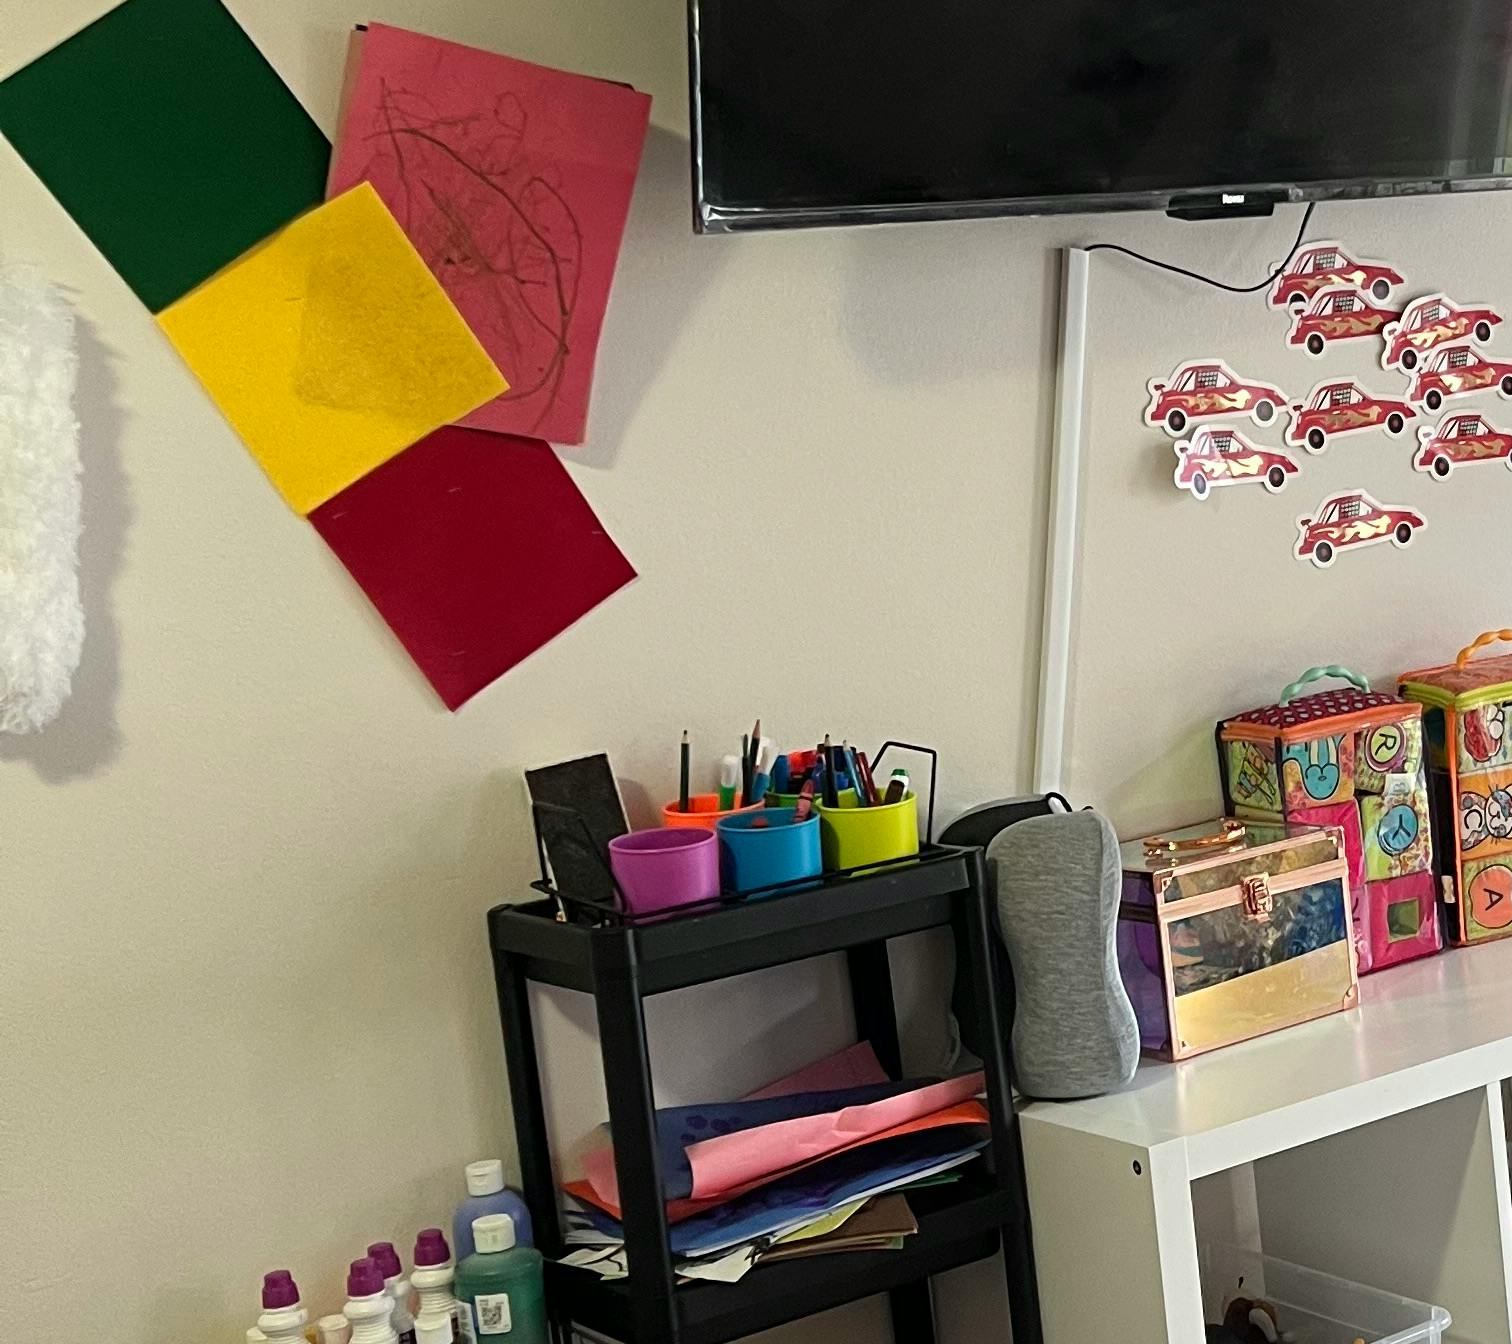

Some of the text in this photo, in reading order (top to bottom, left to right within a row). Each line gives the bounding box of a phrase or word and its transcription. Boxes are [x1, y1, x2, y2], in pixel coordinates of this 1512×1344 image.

[1374, 732, 1398, 756] R
[1392, 813, 1412, 841] Y
[1482, 887, 1504, 912] A
